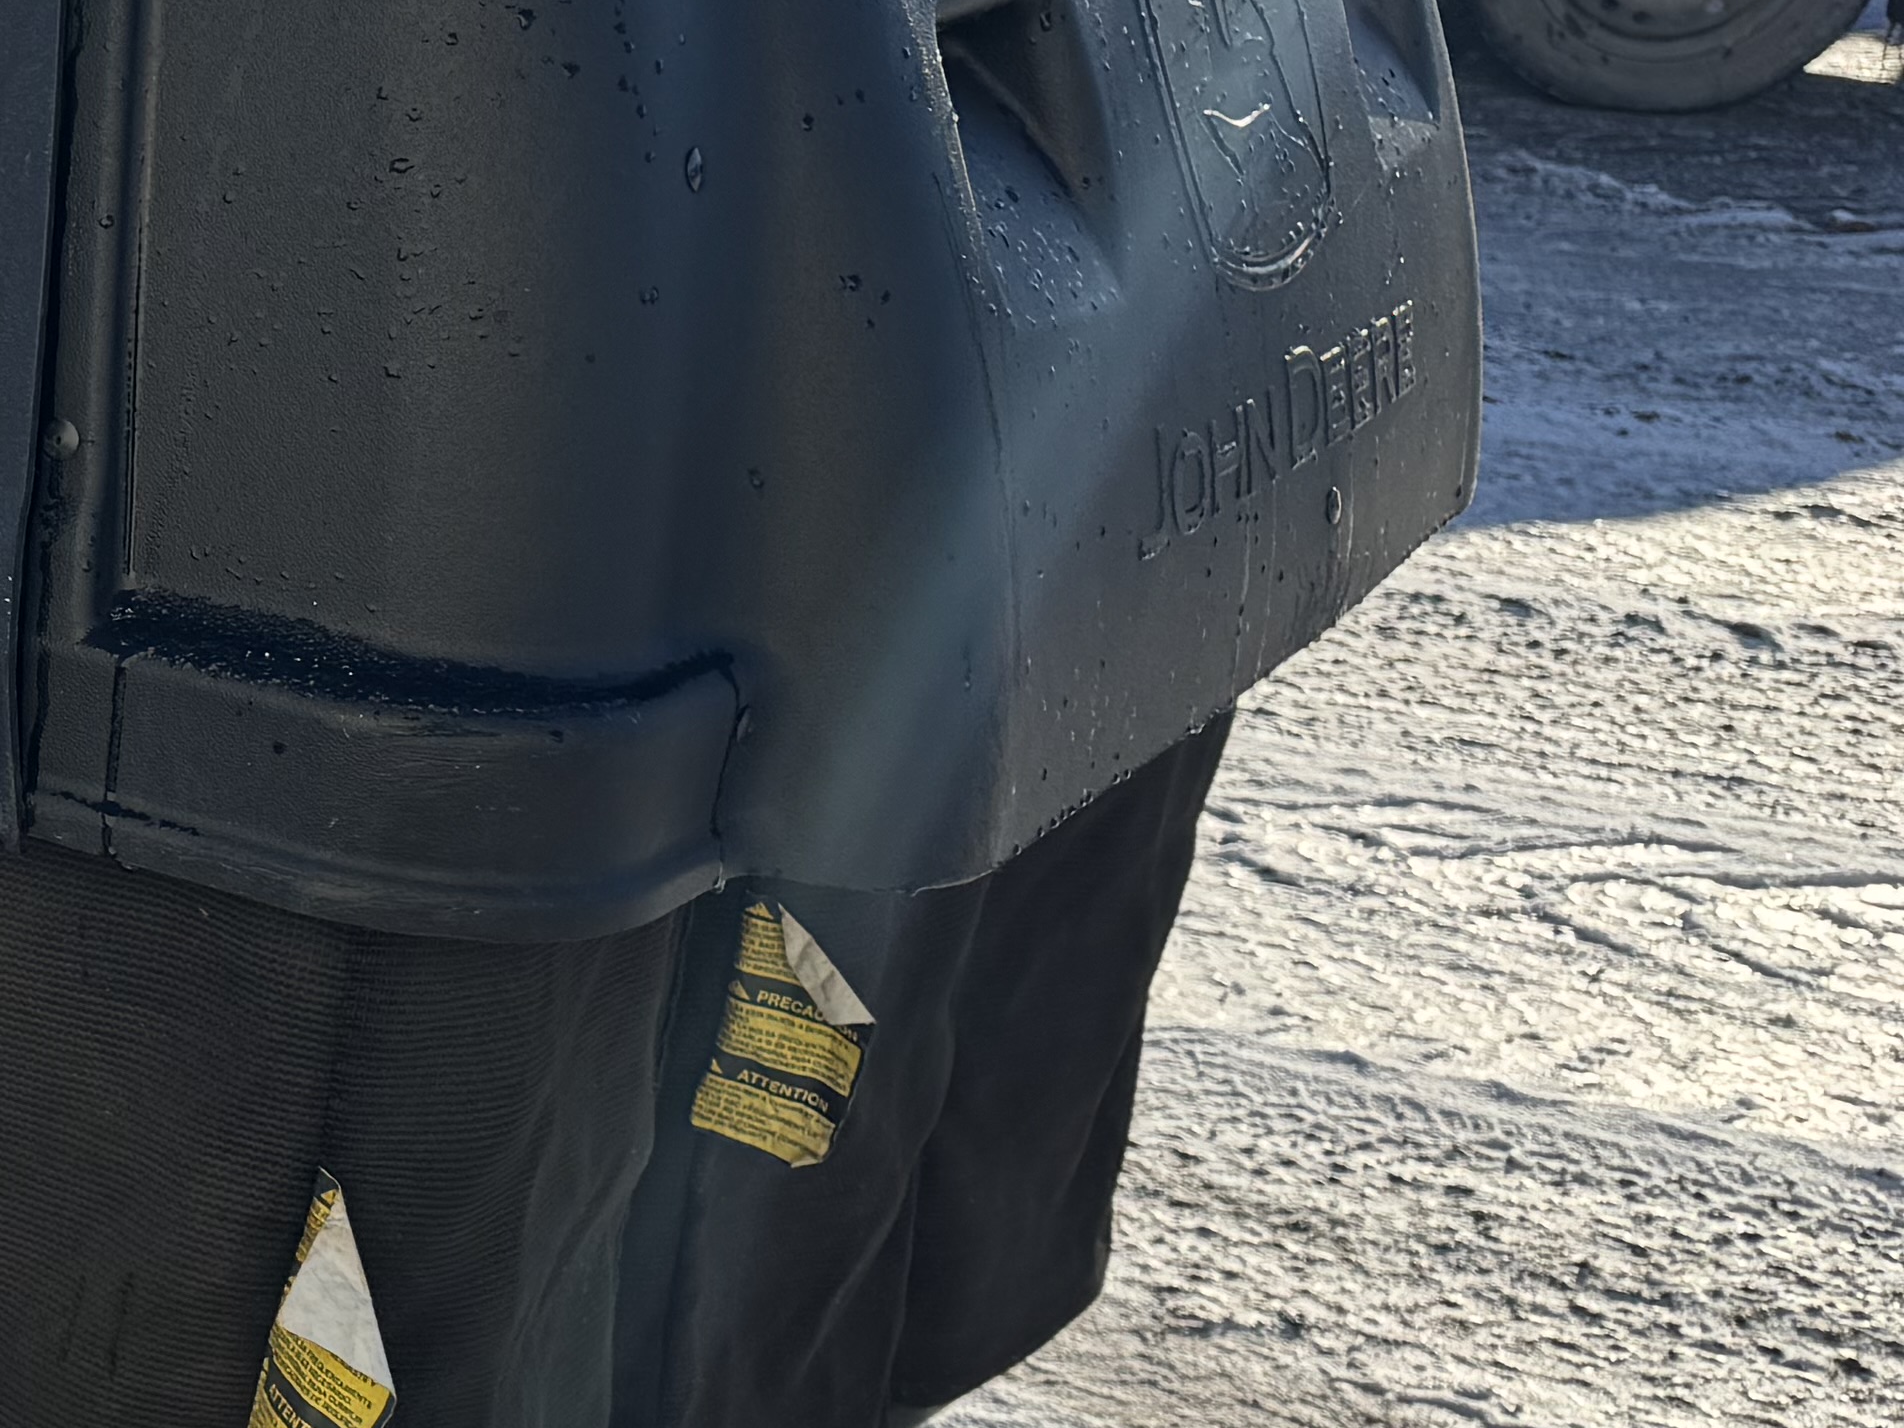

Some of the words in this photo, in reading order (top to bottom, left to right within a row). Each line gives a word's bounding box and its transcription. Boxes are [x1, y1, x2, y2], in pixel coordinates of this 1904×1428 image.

[1137, 386, 1279, 561] JOHN
[1283, 300, 1416, 471] DEERE
[736, 1068, 829, 1113] ATTENTION
